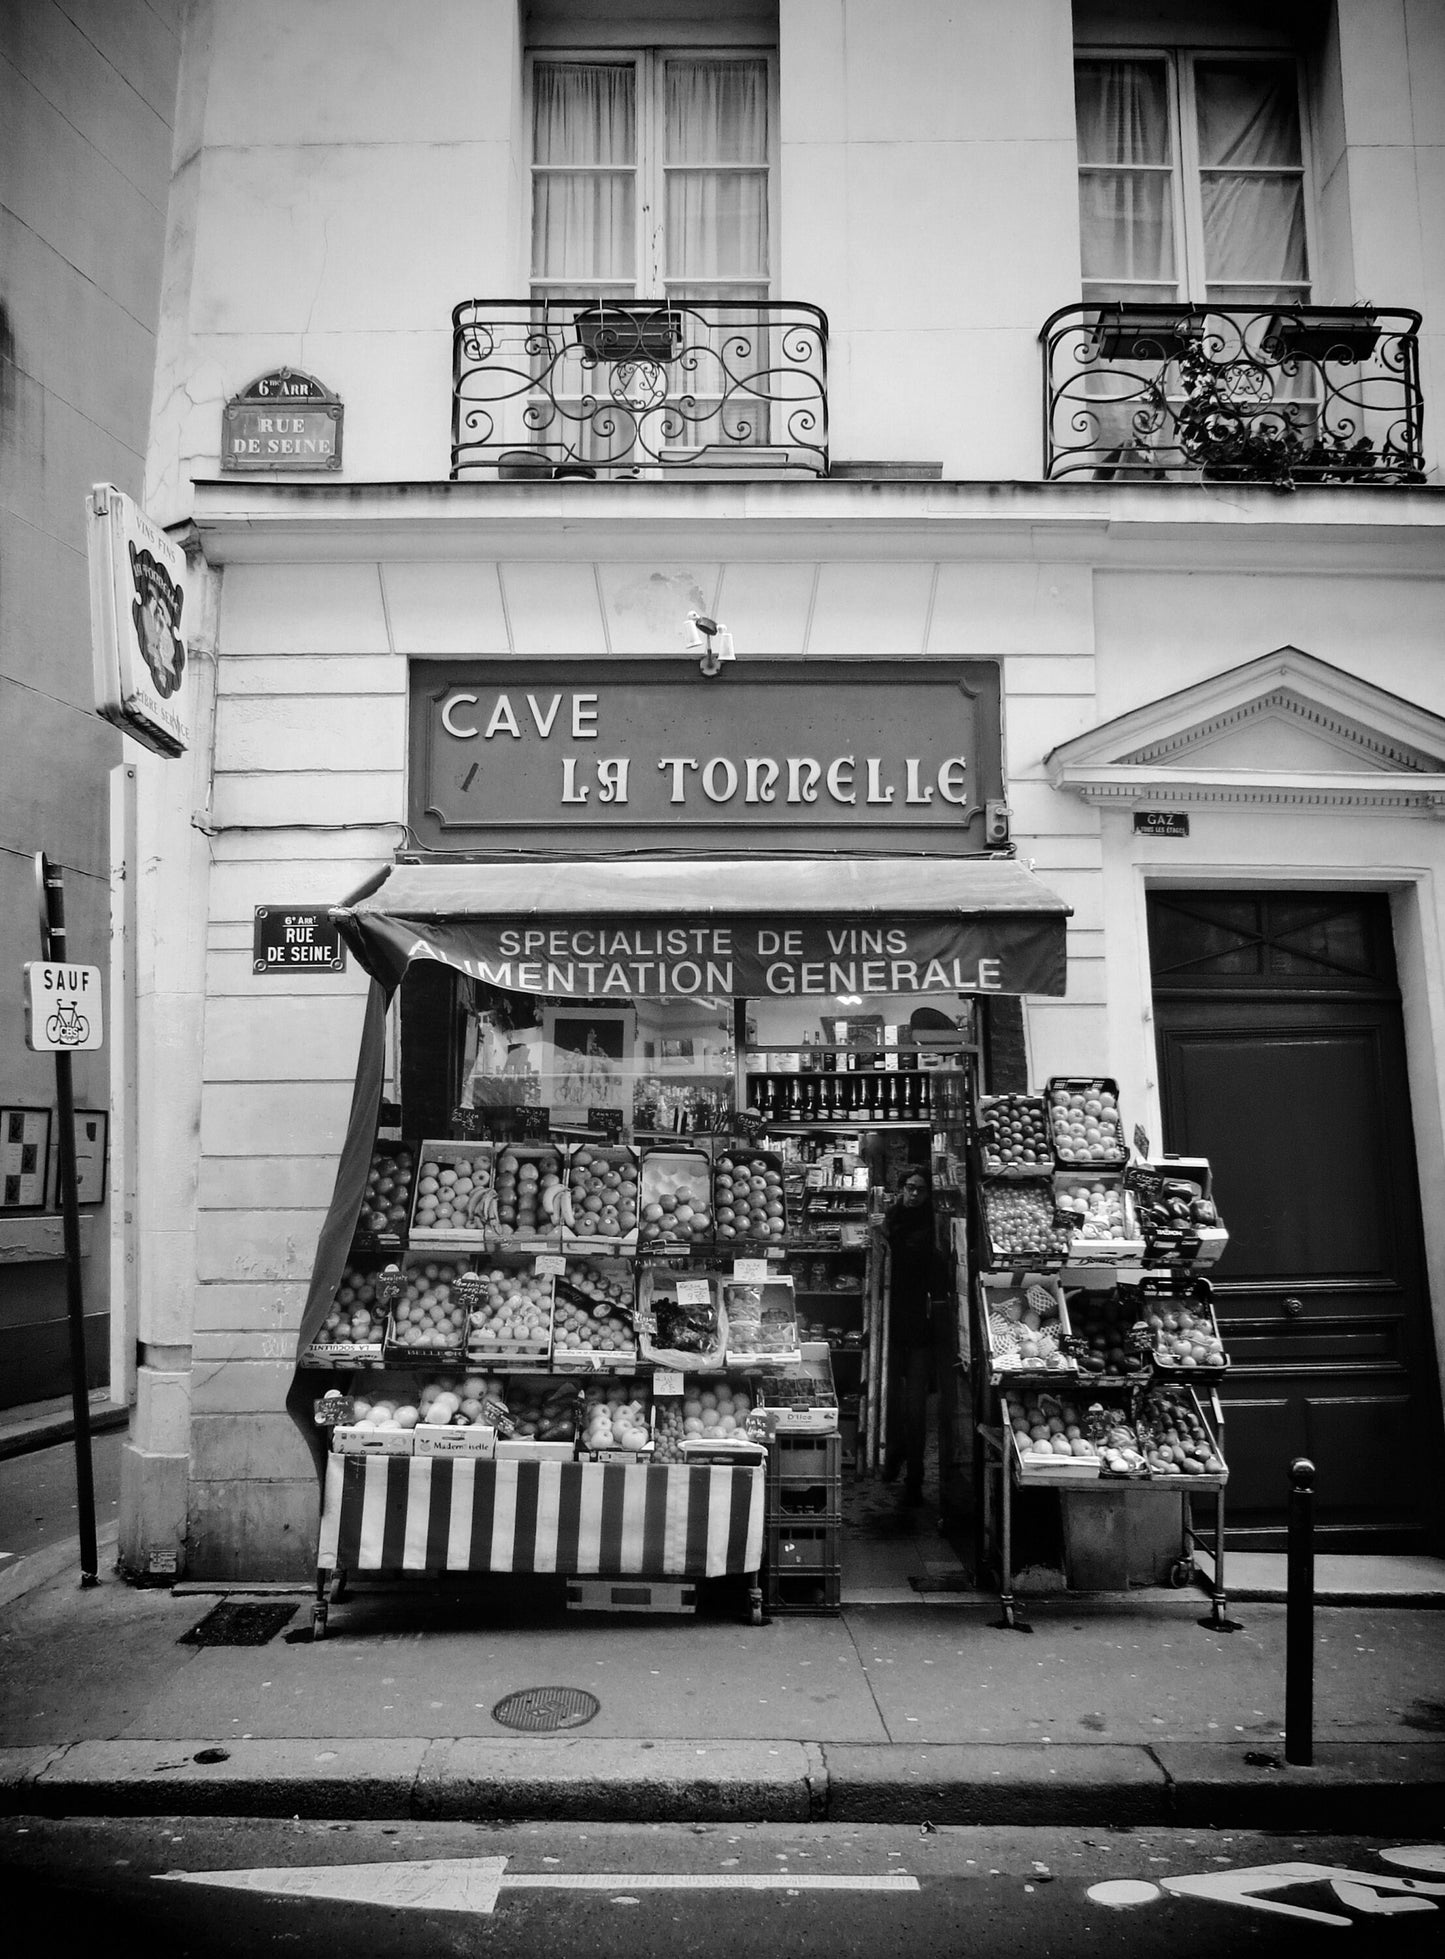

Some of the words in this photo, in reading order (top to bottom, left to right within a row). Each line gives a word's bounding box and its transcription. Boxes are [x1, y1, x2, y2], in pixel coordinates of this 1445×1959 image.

[258, 418, 305, 433] RUE
[233, 439, 261, 454] DE
[267, 439, 331, 454] SEINE
[441, 693, 598, 738] CAVE
[657, 755, 967, 805] TONNELLE
[1147, 813, 1174, 825] GAZ
[286, 928, 314, 943] RUE
[499, 929, 732, 956] SPECIALISTE
[757, 930, 803, 955] DE
[827, 929, 908, 955] VINS
[267, 946, 286, 962] DE
[291, 946, 332, 962] SEINE
[408, 940, 733, 993] ALIMENTATION
[765, 958, 1002, 994] GENERALE
[43, 969, 90, 992] SAUF
